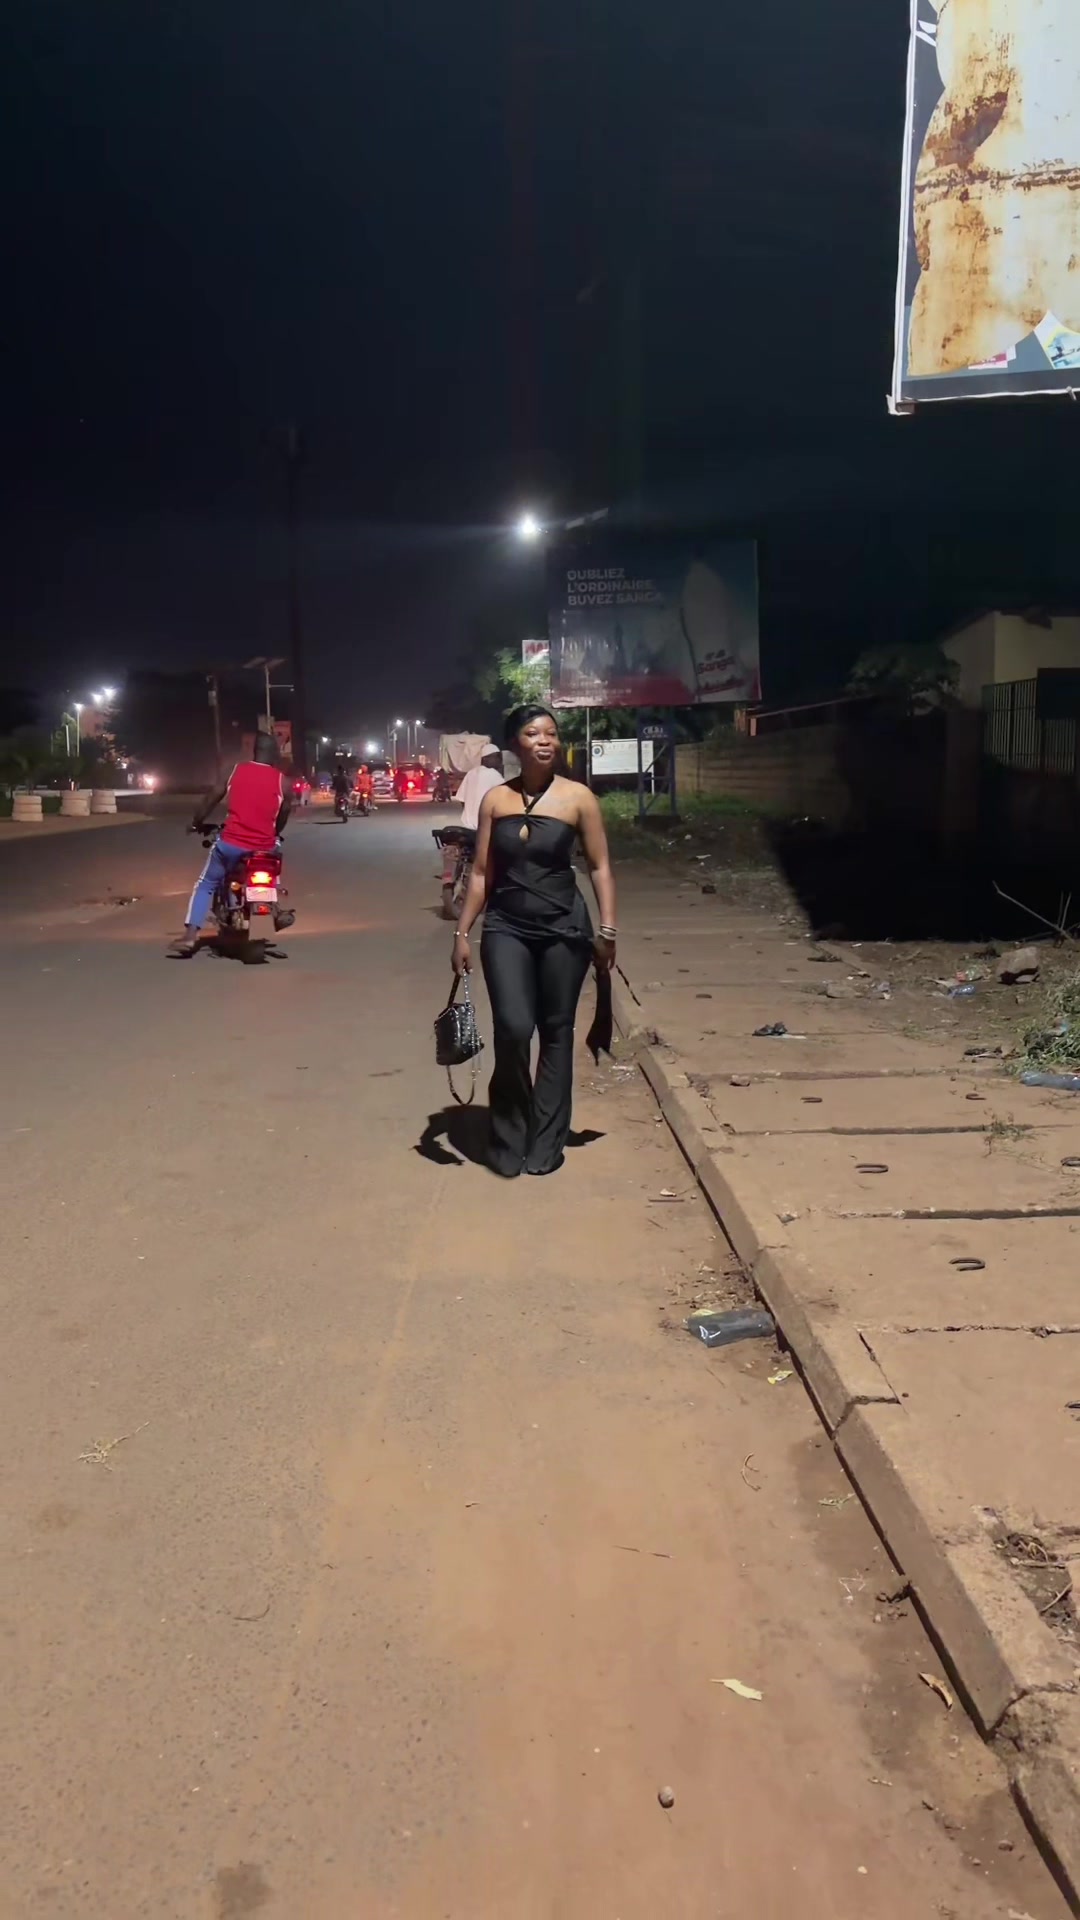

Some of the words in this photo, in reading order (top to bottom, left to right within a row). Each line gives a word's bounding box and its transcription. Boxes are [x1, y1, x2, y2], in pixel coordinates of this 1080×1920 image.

[567, 567, 625, 580] OUBLIEZ
[567, 580, 655, 593] L'ORDINAIRE
[568, 594, 613, 606] BUVEZ
